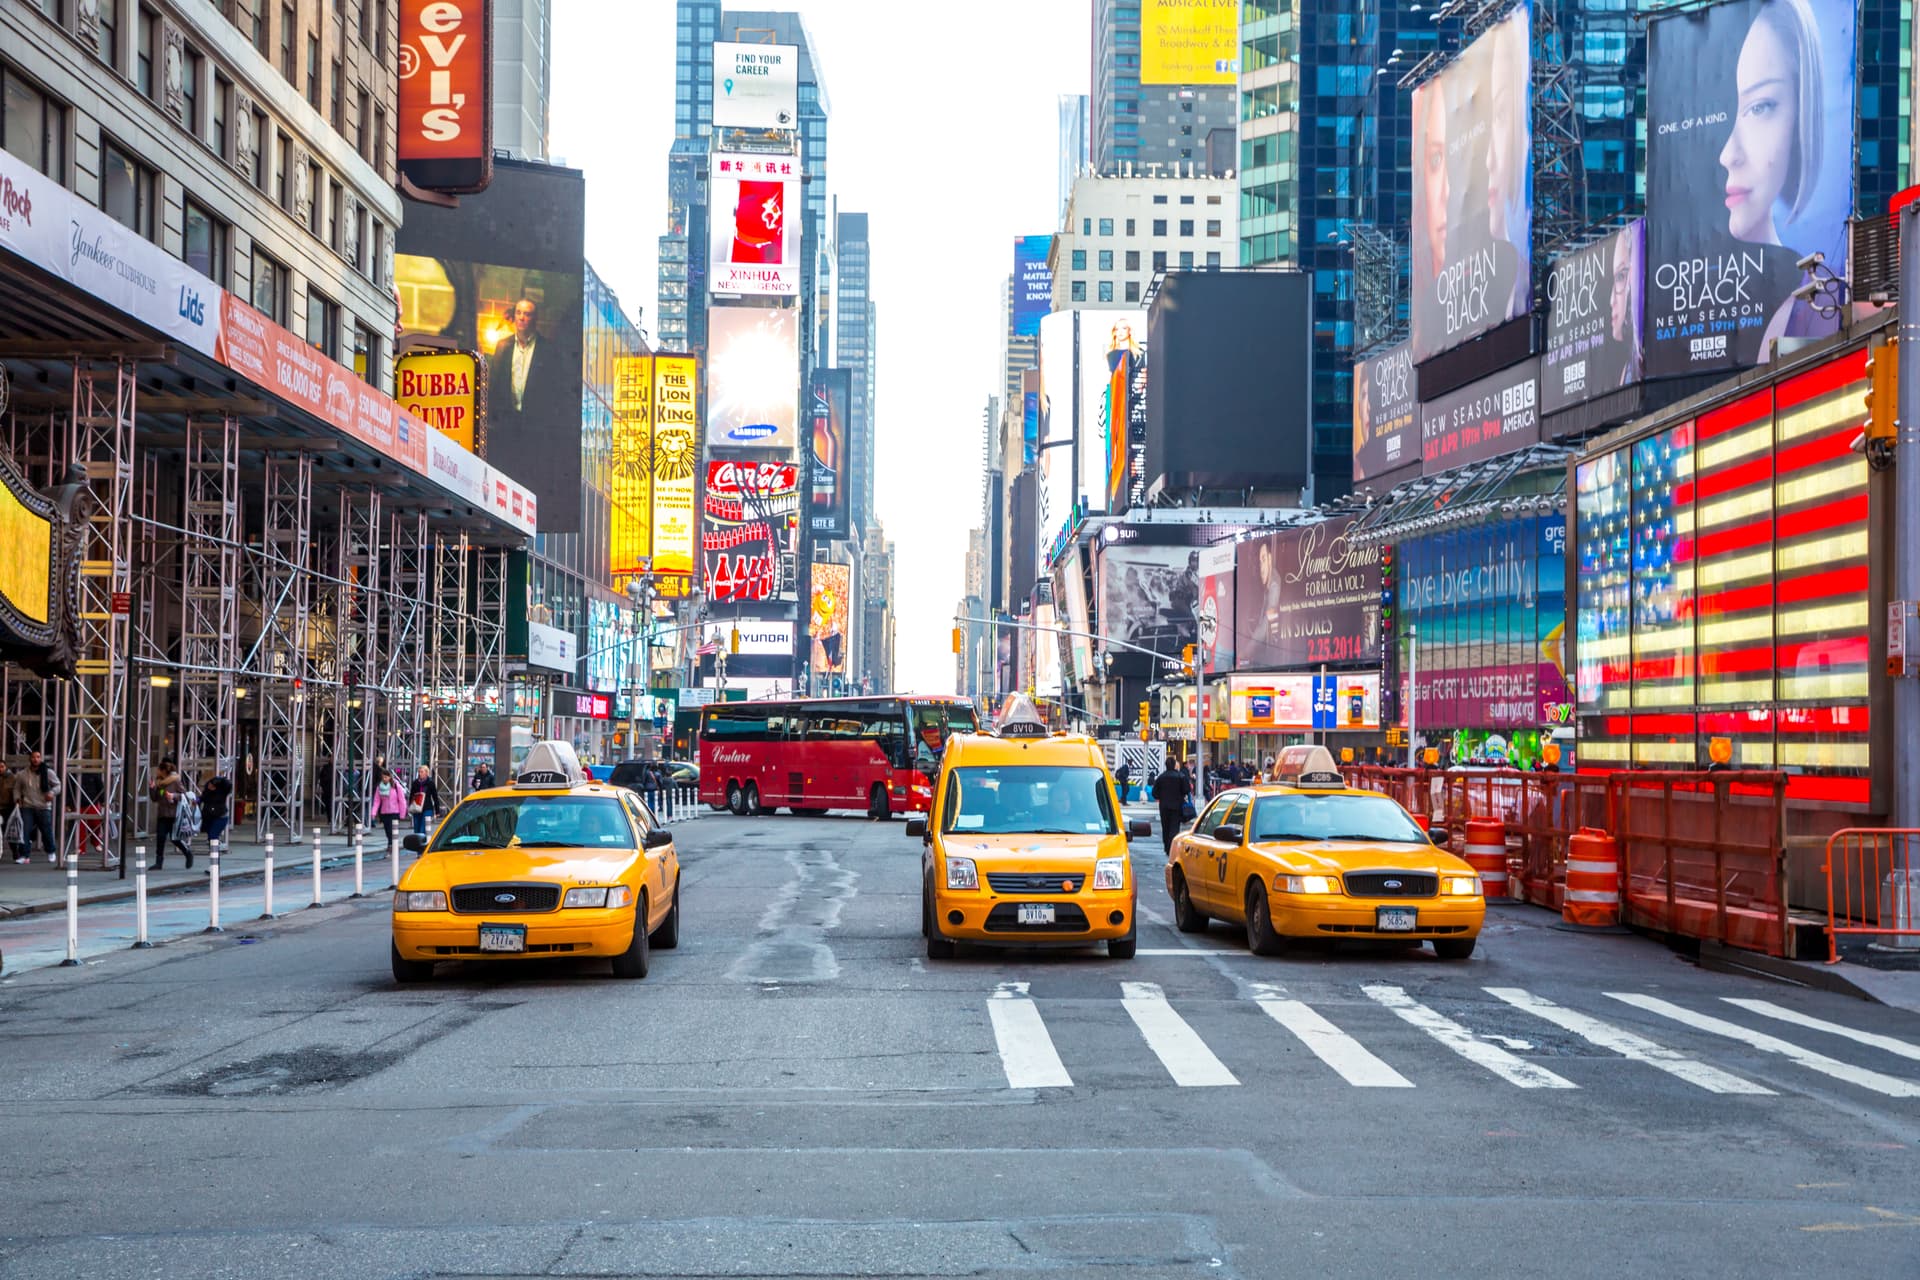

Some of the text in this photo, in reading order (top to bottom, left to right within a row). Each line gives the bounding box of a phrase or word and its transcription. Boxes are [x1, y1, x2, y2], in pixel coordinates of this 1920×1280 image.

[1160, 39, 1209, 48] Broadway
[735, 65, 769, 75] CAREER
[736, 53, 782, 64] FIND YOUR
[1681, 118, 1694, 130] OF
[1696, 116, 1703, 127] A
[116, 259, 157, 295] CLUBHOUSE
[730, 269, 781, 282] XINHUA
[1437, 241, 1496, 304] ORPHAN
[1547, 247, 1605, 301] ORPHAN
[1655, 247, 1764, 289] ORPHAN
[754, 282, 792, 291] GENCY
[1027, 282, 1049, 290] THEY
[1673, 275, 1751, 312] BLACK
[179, 284, 204, 326] Lids
[1447, 280, 1489, 335] BLACK
[1556, 281, 1598, 327] BLACK
[1656, 303, 1764, 327] NEW SEASON
[1547, 316, 1605, 350] NEW SEASON
[1656, 316, 1764, 341] SAT APR 19TH 9PM
[1690, 335, 1727, 353] BBC
[1690, 350, 1727, 361] AMERICA
[663, 374, 686, 385] THE
[1375, 348, 1413, 387] ORPHAN
[1564, 361, 1585, 384] BBC
[402, 369, 470, 397] BUBBA
[659, 387, 690, 403] LION
[1381, 373, 1409, 408] BLACK
[1564, 380, 1585, 394] AMERICA
[1502, 379, 1536, 416] BBC
[657, 405, 693, 423] KING
[1424, 393, 1501, 438] NEW SEASON
[1502, 409, 1536, 434] AMERICA
[1424, 438, 1439, 463] SAT
[1441, 431, 1458, 456] APR
[1461, 425, 1480, 449] 19TH
[1554, 540, 1565, 554] F
[1305, 580, 1343, 597] FORMULA
[1359, 574, 1365, 589] 2
[1407, 541, 1526, 616] bye bye chilly
[1307, 634, 1362, 662] 2.25.2014
[1432, 678, 1459, 701] FORT
[1461, 673, 1535, 699] LAUDERDALE
[1013, 724, 1033, 733] 8V10
[712, 745, 751, 764] Venture
[530, 773, 553, 783] 2Y77
